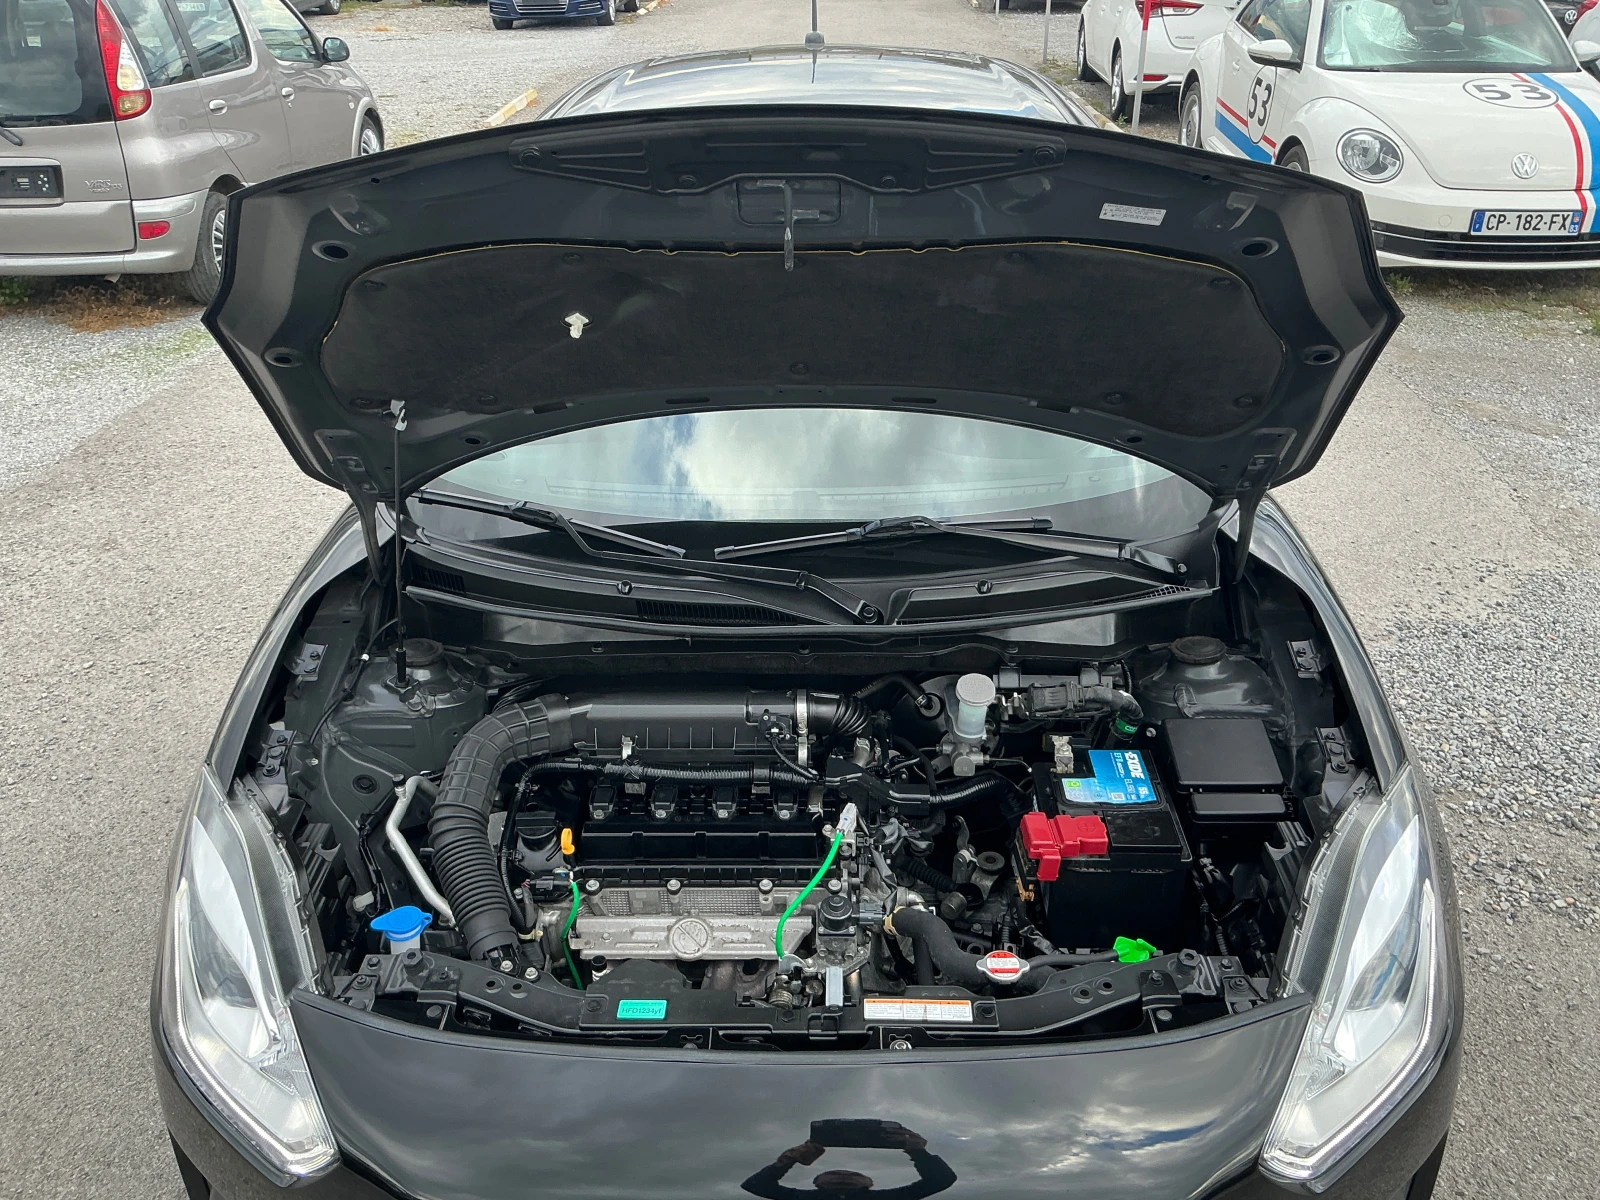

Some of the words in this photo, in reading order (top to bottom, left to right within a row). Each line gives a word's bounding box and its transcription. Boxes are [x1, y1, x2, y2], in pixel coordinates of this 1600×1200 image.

[1472, 84, 1552, 101] 53
[1248, 76, 1272, 127] 53
[1486, 214, 1570, 231] CP-182-FX
[1569, 225, 1579, 233] 83
[1124, 751, 1145, 780] EXIDE
